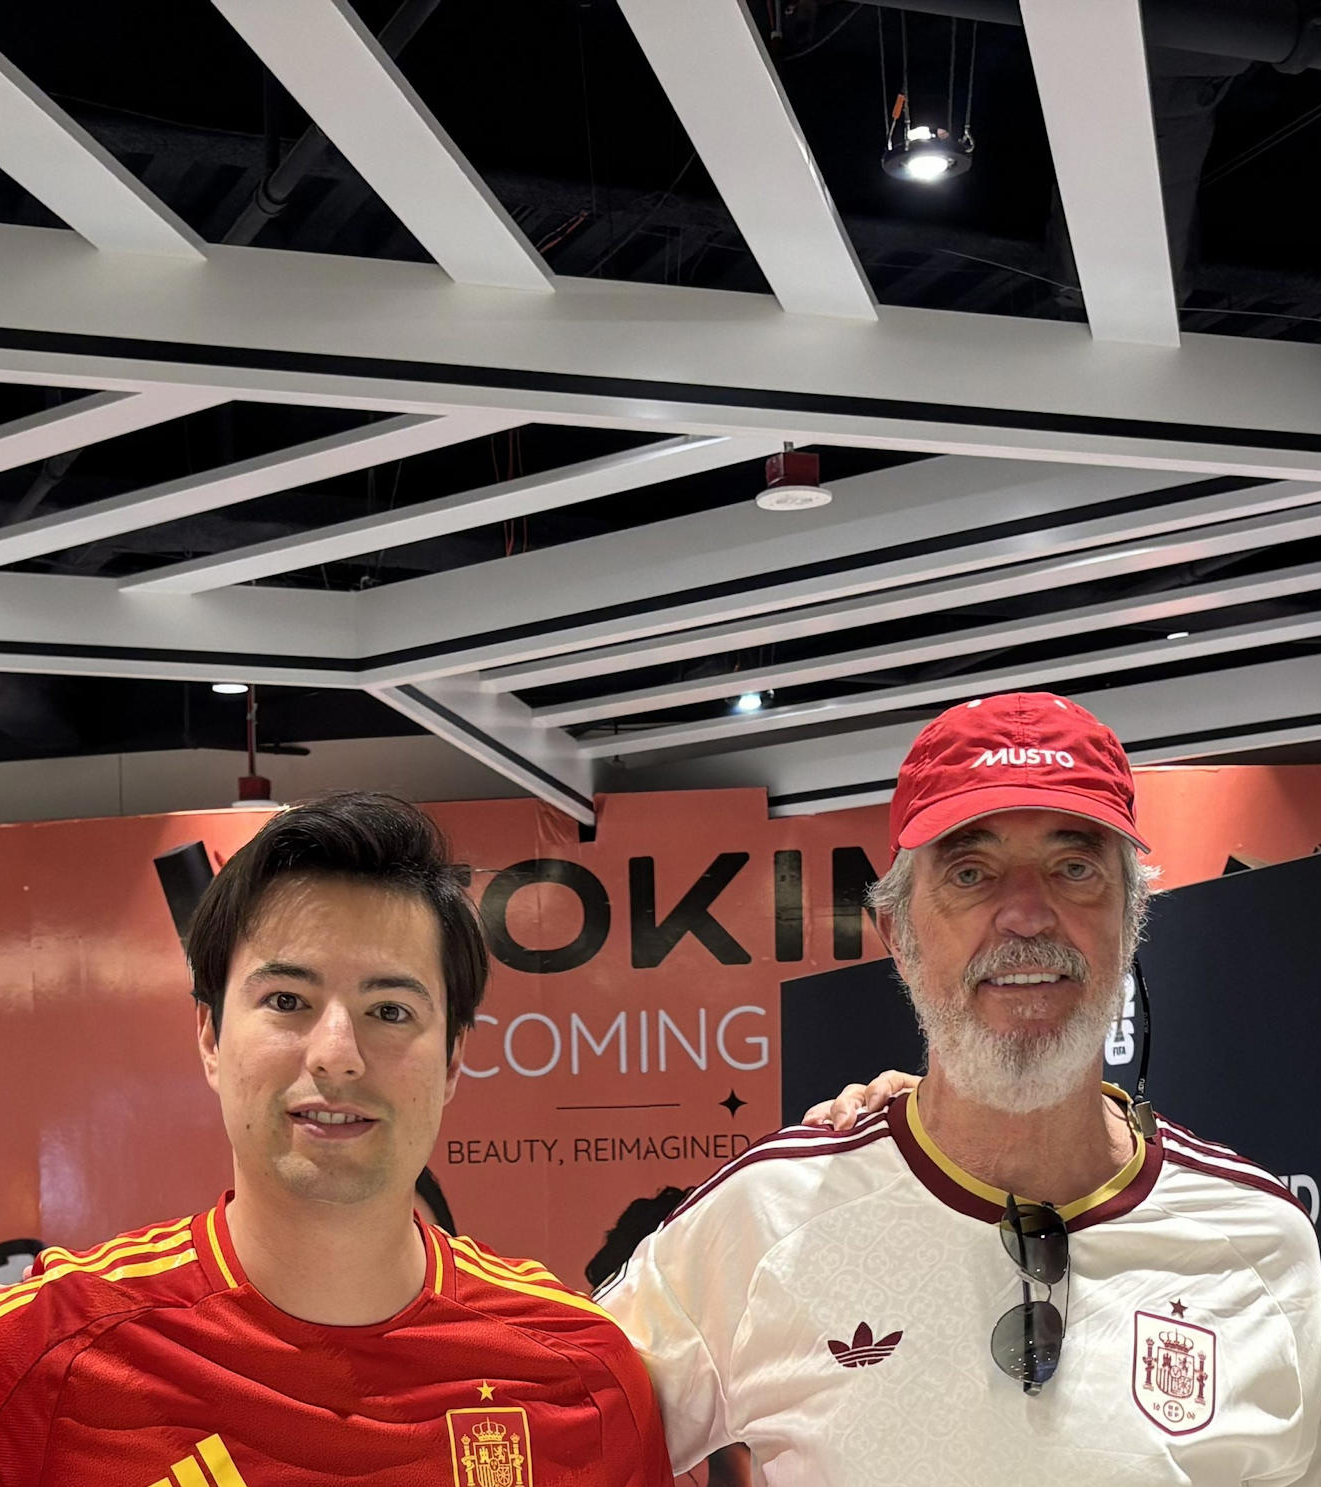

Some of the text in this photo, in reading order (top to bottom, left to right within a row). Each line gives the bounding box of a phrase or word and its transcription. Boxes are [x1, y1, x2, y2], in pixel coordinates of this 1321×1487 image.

[970, 748, 1075, 768] MUSTO
[461, 1005, 769, 1078] COMING
[447, 1134, 751, 1166] BEAUTY, REIMAGINED
